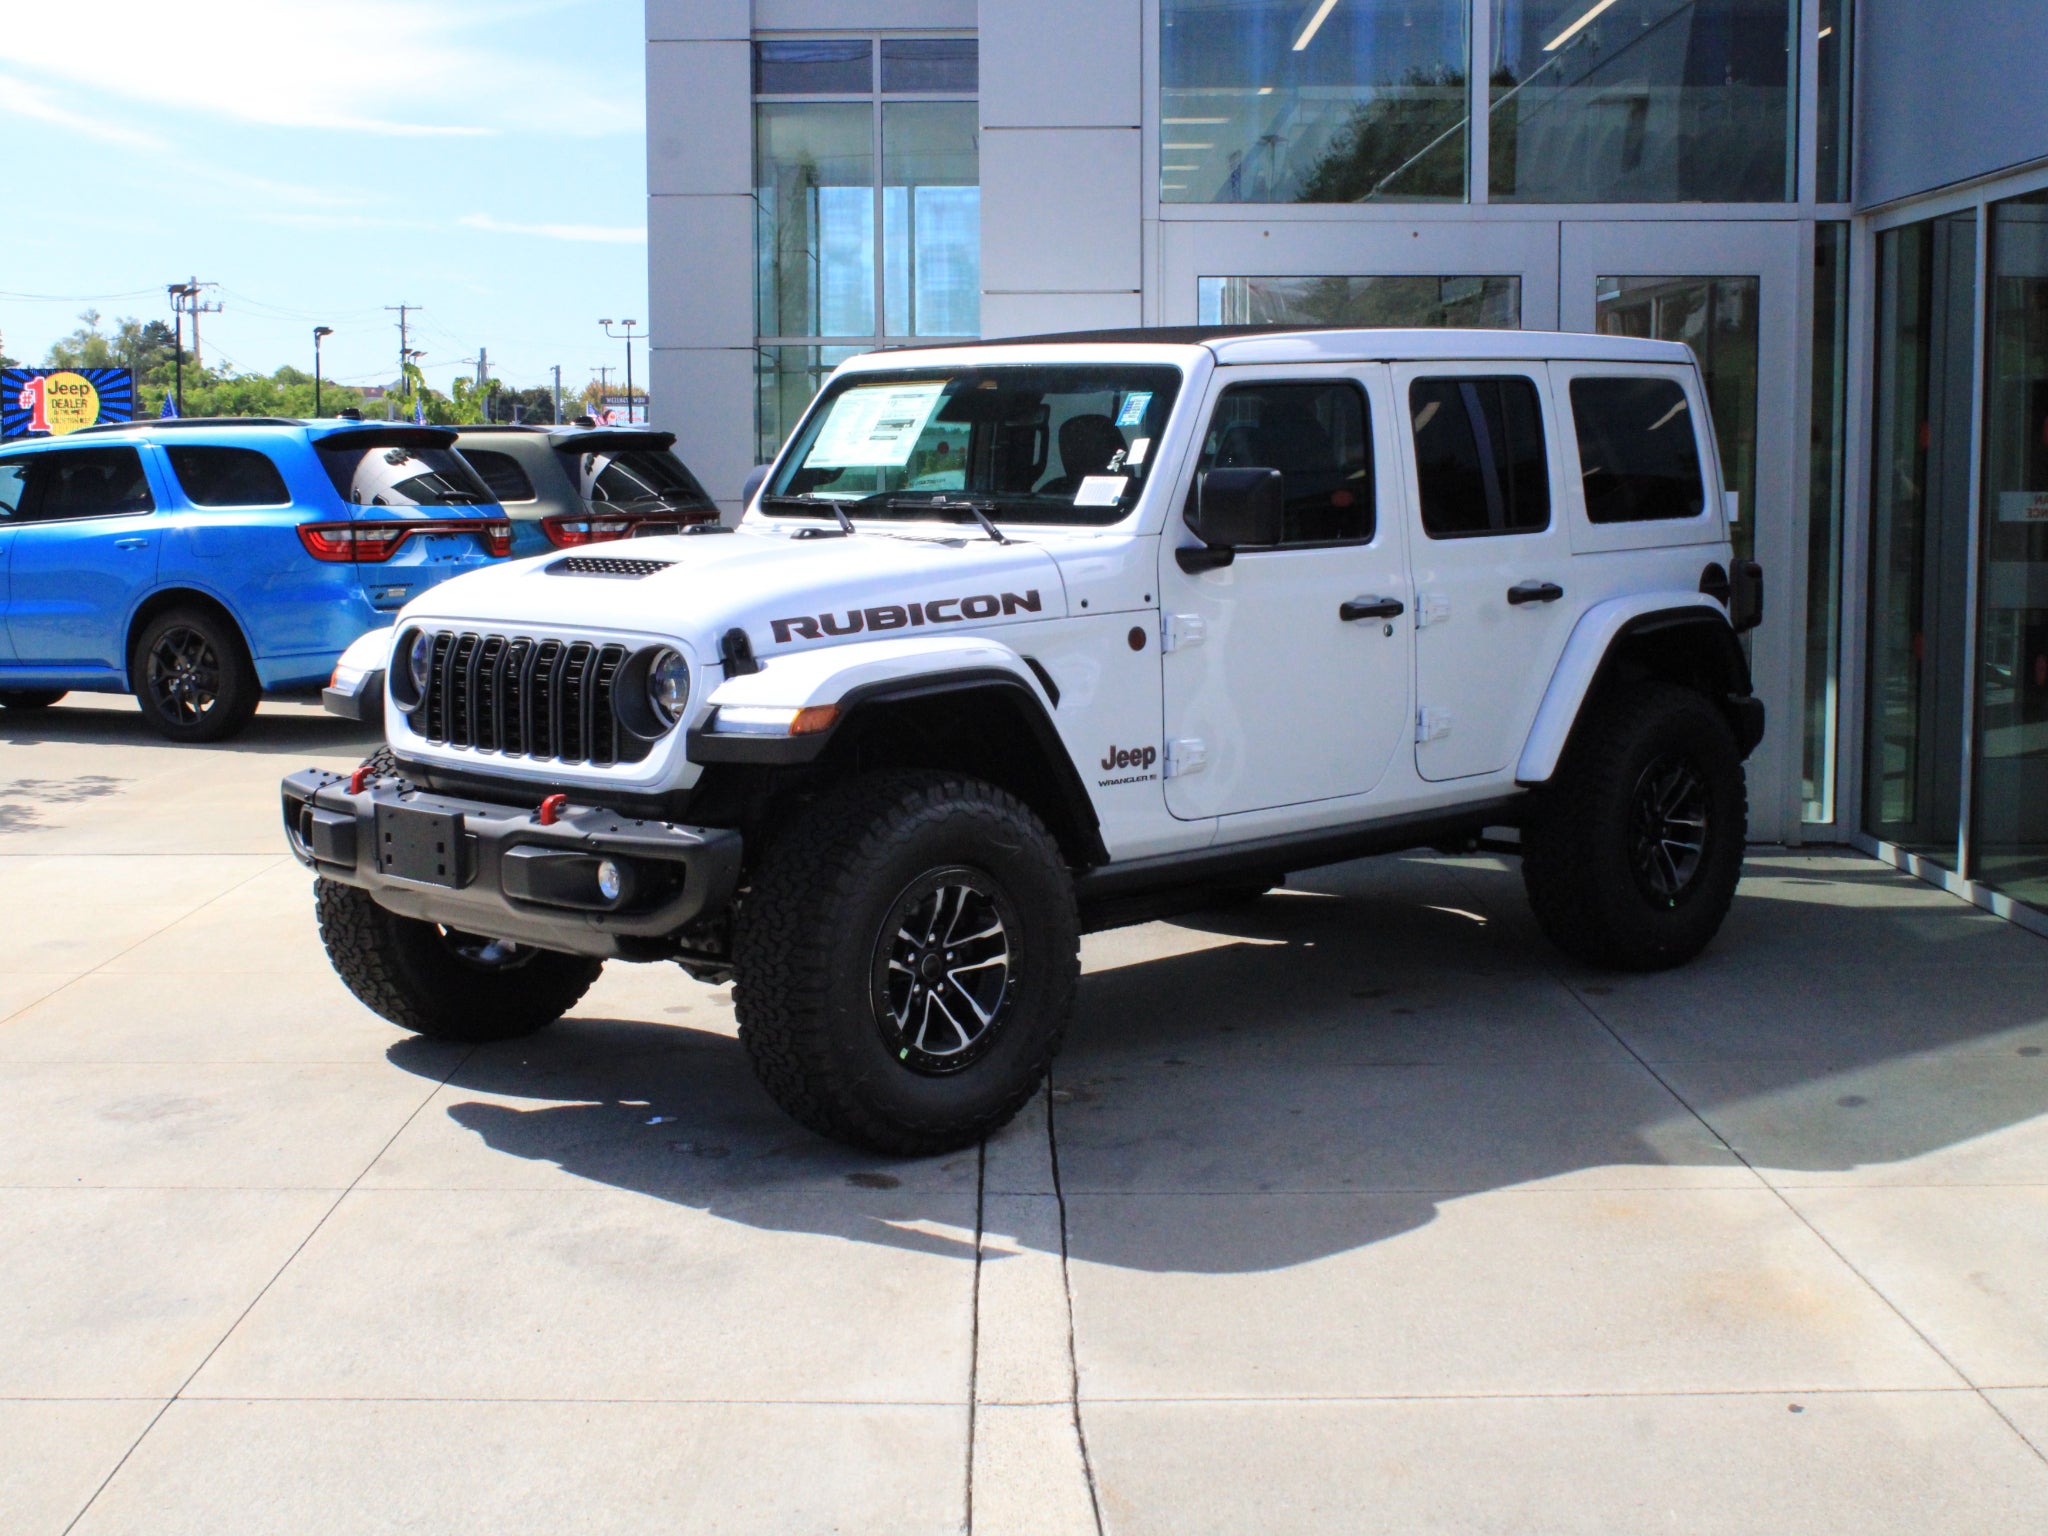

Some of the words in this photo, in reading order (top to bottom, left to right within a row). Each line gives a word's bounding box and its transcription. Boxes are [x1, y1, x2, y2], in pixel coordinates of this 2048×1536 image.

[48, 380, 90, 397] Jeep
[19, 376, 52, 431] #1
[51, 399, 88, 408] DEALER
[770, 589, 1042, 643] RUBICON
[1101, 744, 1156, 770] Jeep
[1098, 775, 1148, 787] WRANGLER
